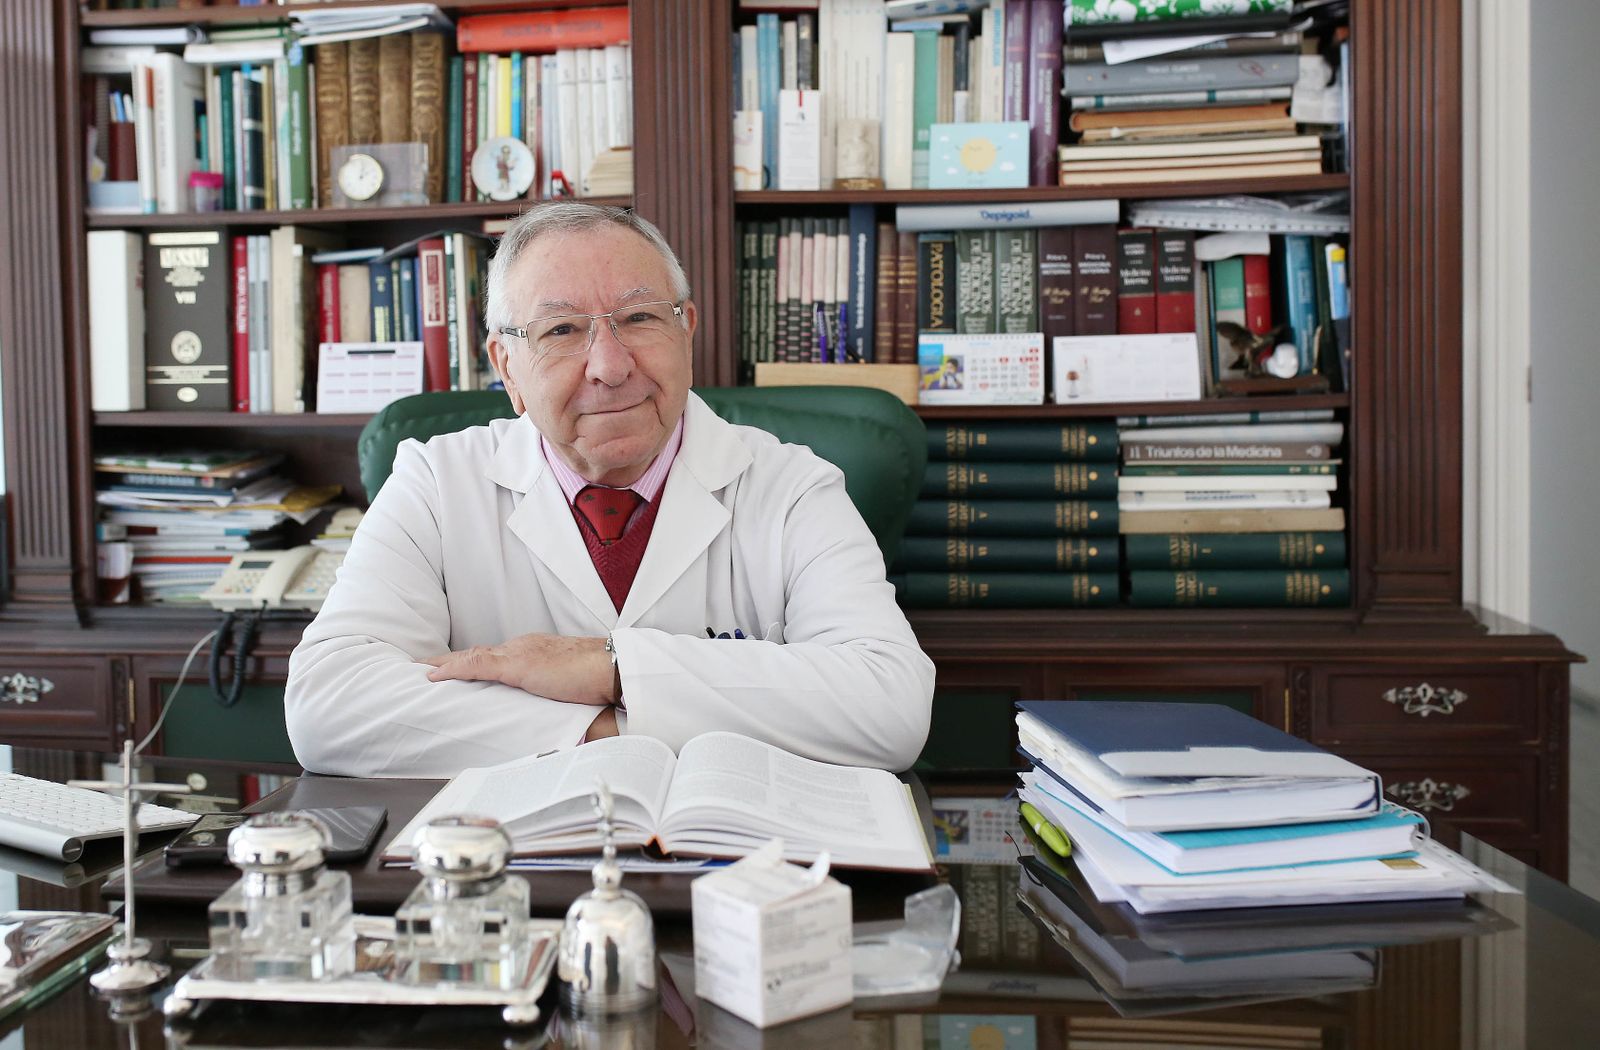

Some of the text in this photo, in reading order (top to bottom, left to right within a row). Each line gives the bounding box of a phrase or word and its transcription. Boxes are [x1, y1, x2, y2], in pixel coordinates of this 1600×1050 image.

[1145, 445, 1196, 458] Triunfos
[1196, 446, 1213, 458] de
[1213, 446, 1226, 458] la
[1226, 446, 1282, 458] Medicina
